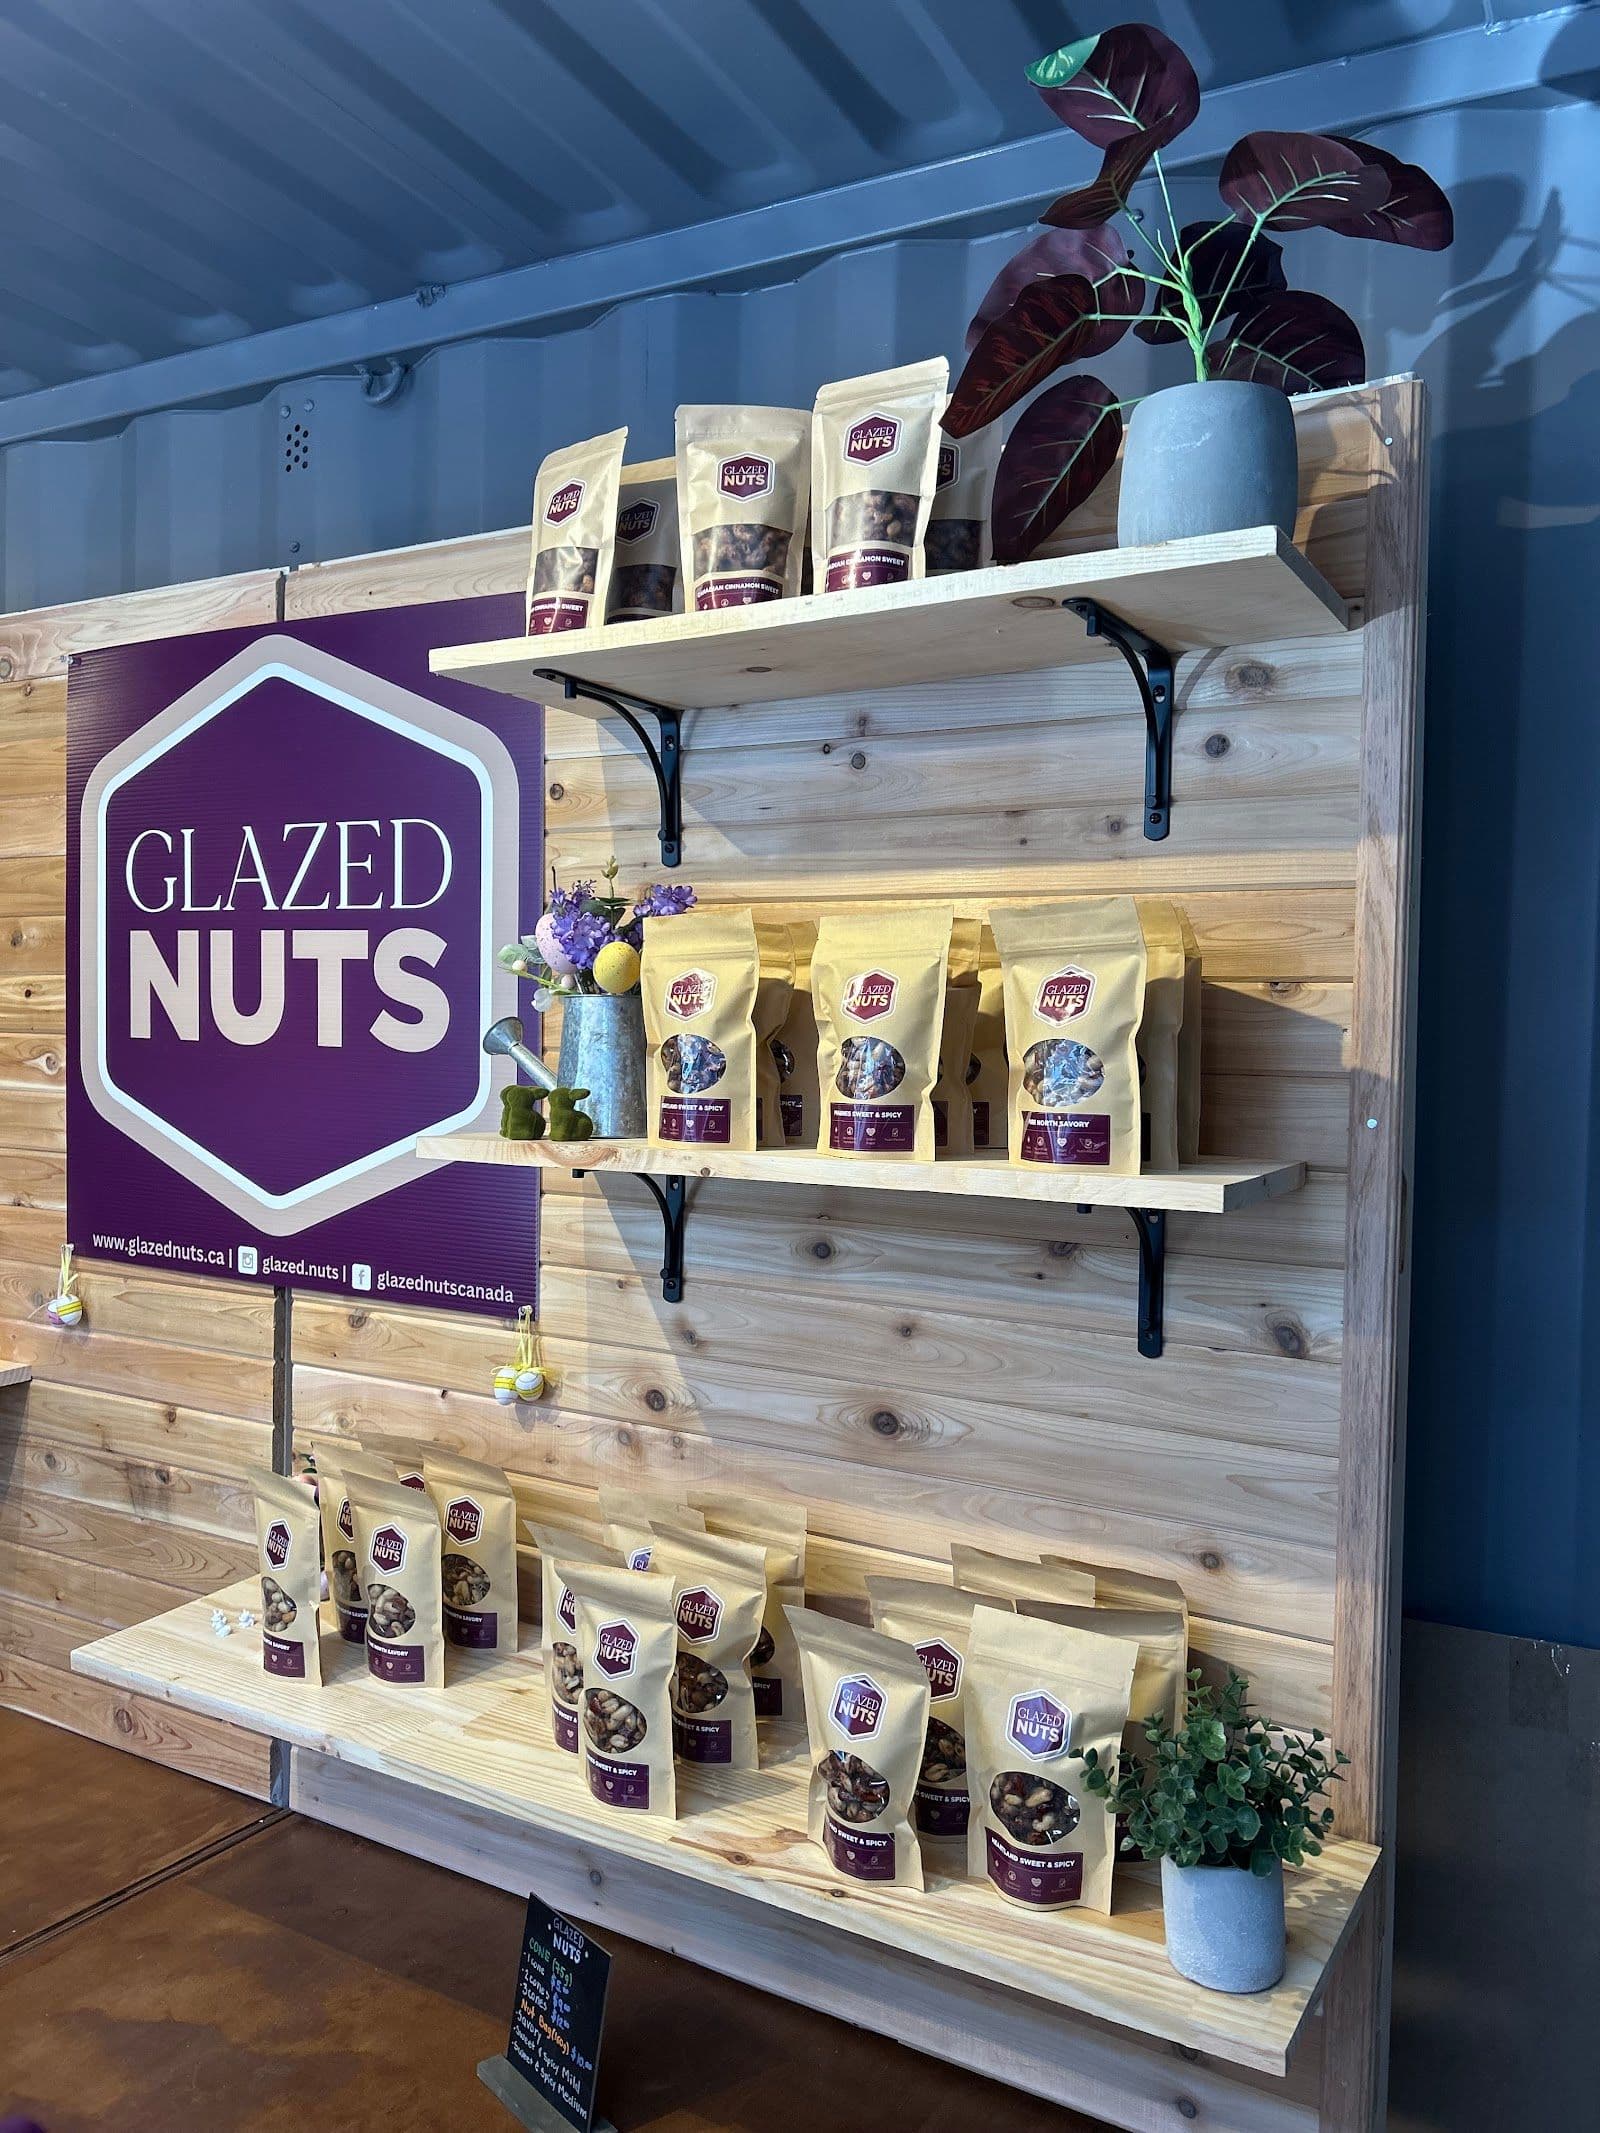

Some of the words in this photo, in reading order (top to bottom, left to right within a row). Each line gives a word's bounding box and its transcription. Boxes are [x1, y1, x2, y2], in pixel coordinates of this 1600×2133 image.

[852, 426, 894, 441] GLAZED
[850, 436, 892, 452] NUTS
[724, 466, 766, 475] GLAZED
[724, 474, 765, 486] NUTS
[552, 490, 580, 504] GLAZED
[549, 499, 576, 514] NUTS
[618, 519, 650, 530] NUTS
[881, 556, 904, 566] SWEET
[761, 584, 779, 595] SWEET
[562, 603, 583, 611] SWEET
[125, 817, 454, 914] GLAZED
[128, 926, 451, 1054] NUTS
[857, 985, 892, 995] LAZED
[1046, 984, 1088, 995] GLAZED
[850, 994, 888, 1007] NUTS
[1042, 994, 1084, 1008] NUTS
[1037, 1119, 1058, 1127] NORTH
[92, 1233, 225, 1265] www.glazednuts.ca
[262, 1255, 339, 1280] glazed.nuts
[377, 1270, 514, 1303] glazednutscanada
[341, 1513, 352, 1525] NU
[450, 1508, 479, 1522] GLAZED
[448, 1519, 476, 1533] NUTS
[268, 1541, 286, 1559] NUTS
[376, 1535, 402, 1551] GLAZED
[374, 1545, 400, 1562] NUTS
[681, 1599, 716, 1618] GLAZED
[679, 1610, 713, 1630] NUTS
[600, 1632, 633, 1651] GLAZED
[599, 1643, 630, 1665] NUTS
[927, 1671, 954, 1688] UTS
[842, 1688, 880, 1711] GLAZED
[838, 1700, 876, 1727] NUTS
[1017, 1707, 1062, 1729] GLAZED
[1016, 1721, 1059, 1744] NUTS
[921, 1792, 943, 1801] SWEET
[838, 1831, 858, 1844] SWEET
[866, 1839, 888, 1847] SPICY
[1020, 1857, 1046, 1868] SWEET
[1046, 1861, 1053, 1869] &
[1054, 1860, 1076, 1869] SPICY
[553, 1917, 584, 1949] GLAZED
[529, 1937, 551, 1962] CONE
[553, 1932, 581, 1964] NUTS
[521, 1998, 535, 2020] Nut
[562, 2066, 581, 2095] Mild
[558, 2083, 588, 2120] Medium
